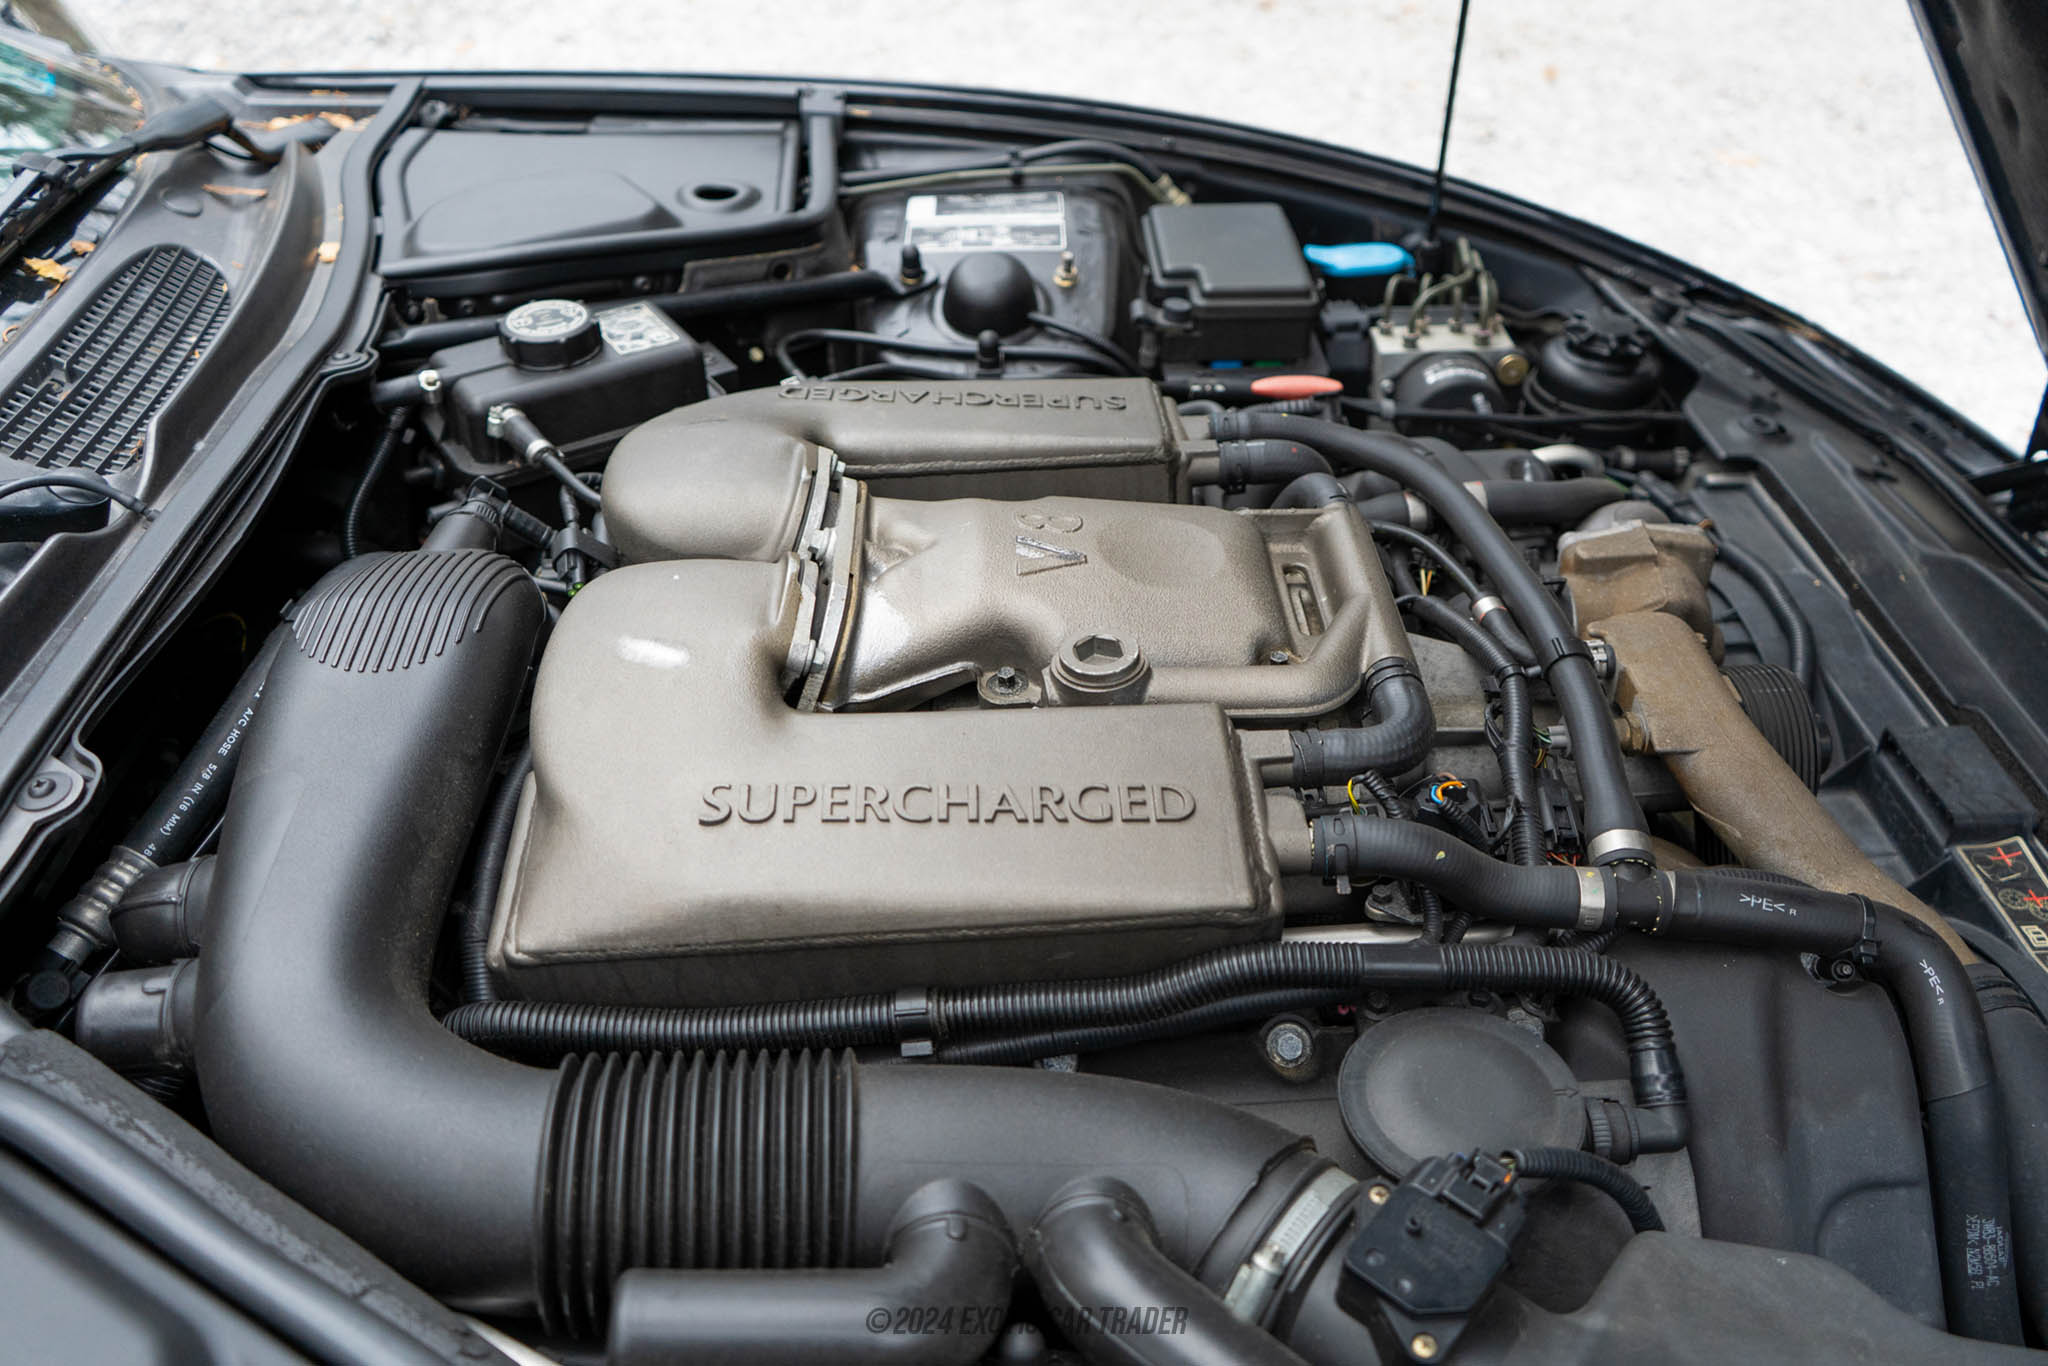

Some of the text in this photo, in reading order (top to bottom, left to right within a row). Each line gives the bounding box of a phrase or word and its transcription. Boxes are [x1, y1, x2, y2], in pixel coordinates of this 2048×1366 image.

[778, 385, 1127, 410] SUPERCHARGED
[1014, 510, 1088, 577] V8
[237, 707, 254, 727] A/C
[218, 728, 241, 756] HOSE
[201, 763, 218, 781] 5/8
[191, 782, 205, 795] IN
[178, 796, 195, 812] (16
[697, 783, 1198, 827] SUPERCHARGED
[160, 813, 181, 836] MM)
